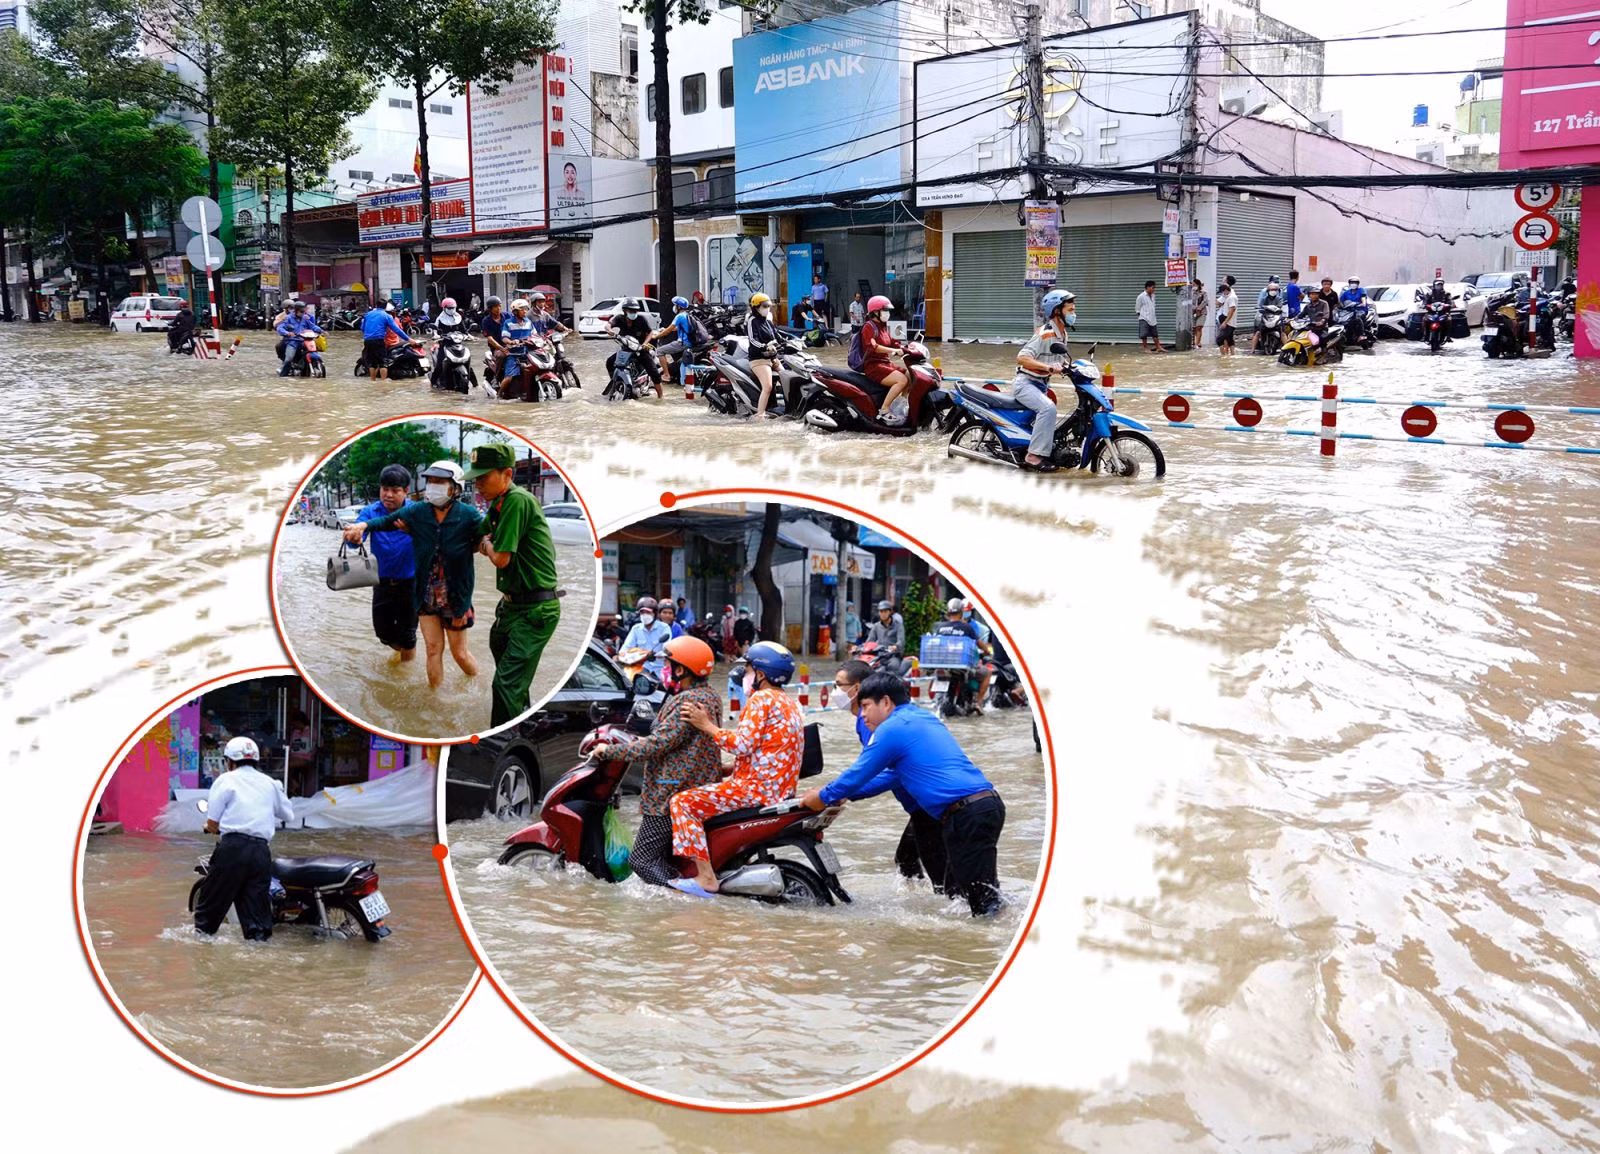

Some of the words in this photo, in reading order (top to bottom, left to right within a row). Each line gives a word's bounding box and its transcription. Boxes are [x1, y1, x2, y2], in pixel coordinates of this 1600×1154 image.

[760, 53, 781, 66] NGÂN
[783, 48, 805, 61] HÀNG
[1533, 118, 1561, 133] 127
